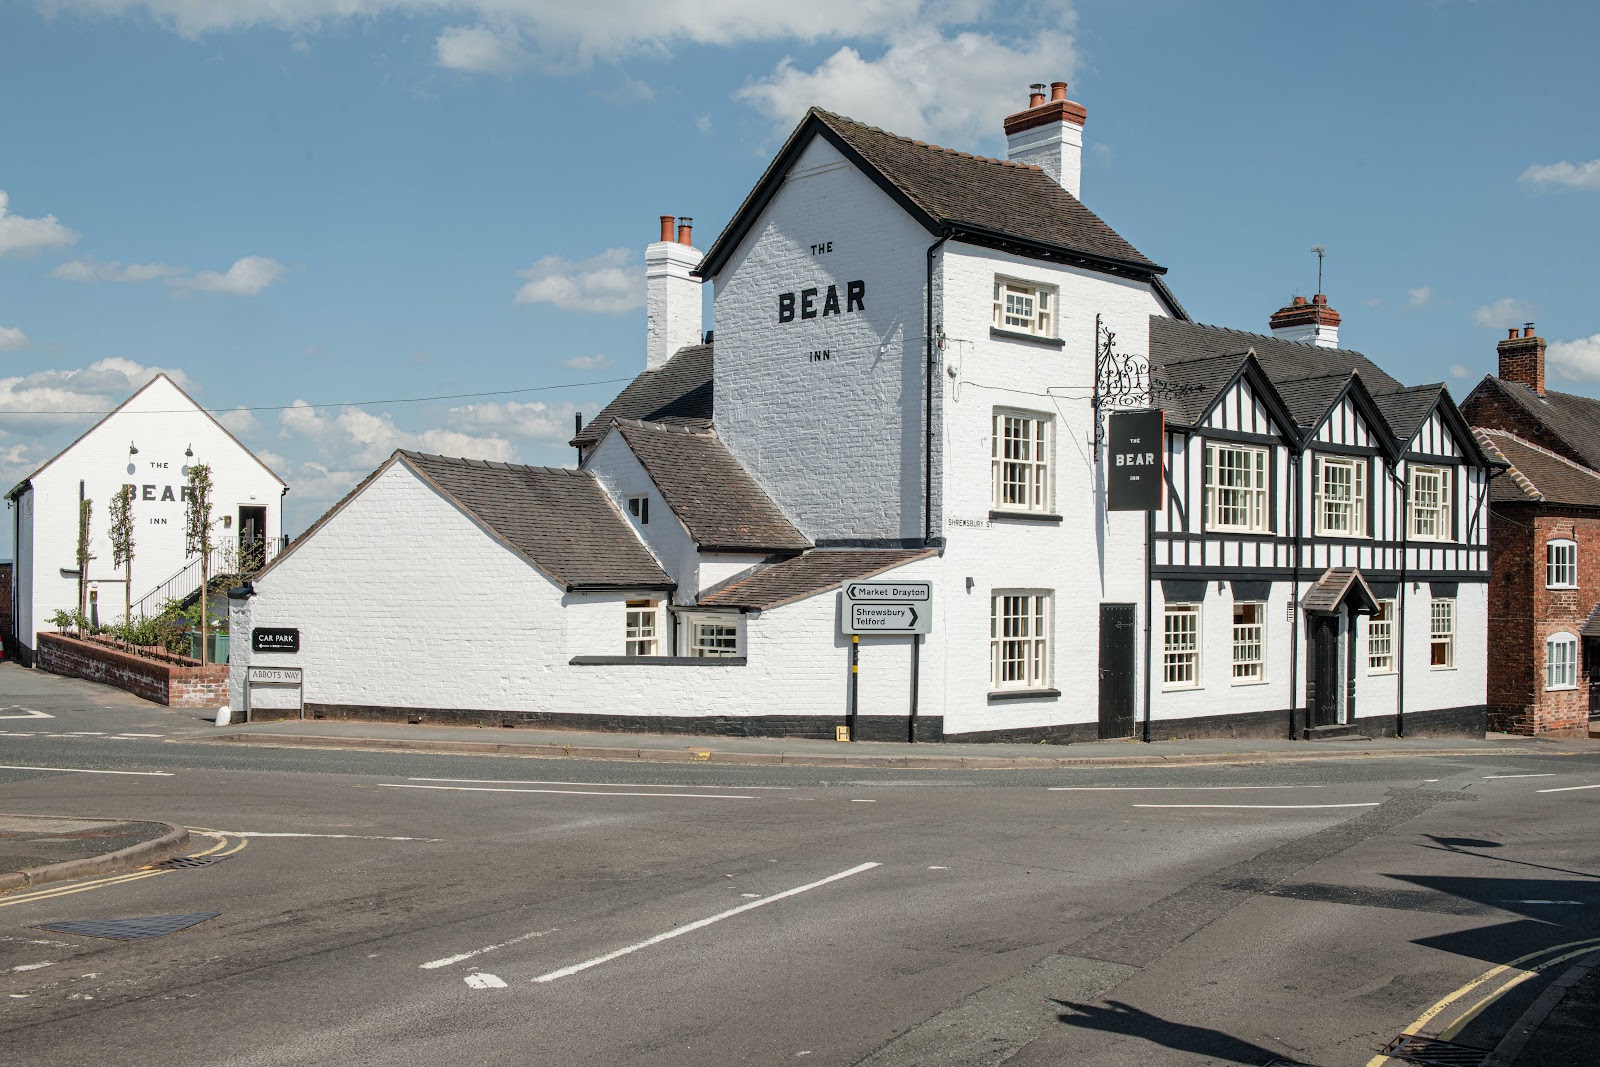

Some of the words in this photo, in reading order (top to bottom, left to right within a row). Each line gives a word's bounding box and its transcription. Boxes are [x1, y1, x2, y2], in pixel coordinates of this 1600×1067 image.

[810, 241, 833, 256] THE
[778, 279, 865, 324] BEAR
[809, 349, 830, 363] INN
[1115, 452, 1155, 467] BEAR
[948, 518, 984, 528] SHREWSBURY
[858, 588, 888, 596] Market
[892, 588, 925, 597] Drayton
[856, 608, 906, 617] Shrewsbury
[856, 617, 886, 625] Telford
[258, 634, 274, 642] CAR
[275, 634, 294, 642] PARK
[252, 670, 282, 679] ABBOTS
[284, 671, 300, 680] WAY
